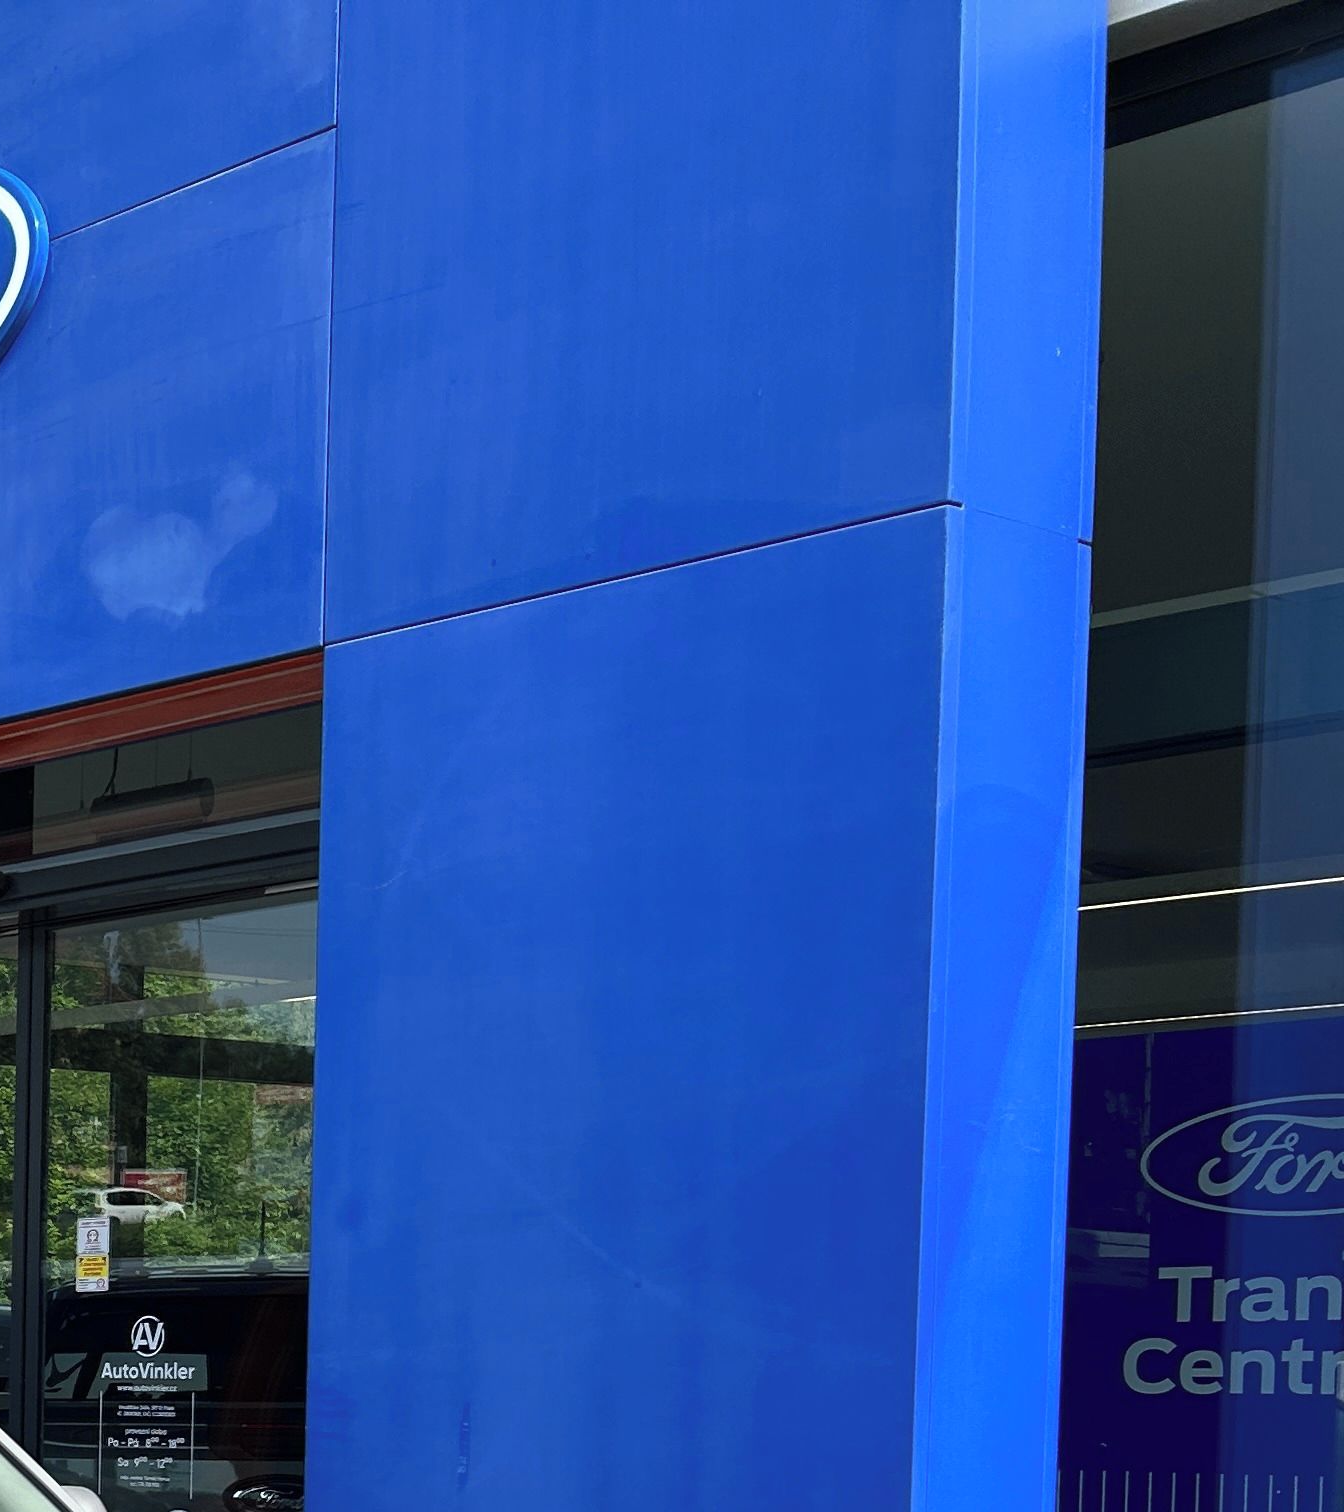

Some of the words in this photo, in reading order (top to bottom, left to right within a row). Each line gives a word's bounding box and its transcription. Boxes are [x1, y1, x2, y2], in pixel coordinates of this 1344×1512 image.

[1157, 1265, 1344, 1323] Tran
[132, 1322, 164, 1351] AV
[100, 1361, 196, 1380] AutoVinkler
[107, 1437, 119, 1447] Po
[117, 1457, 129, 1467] Sa
